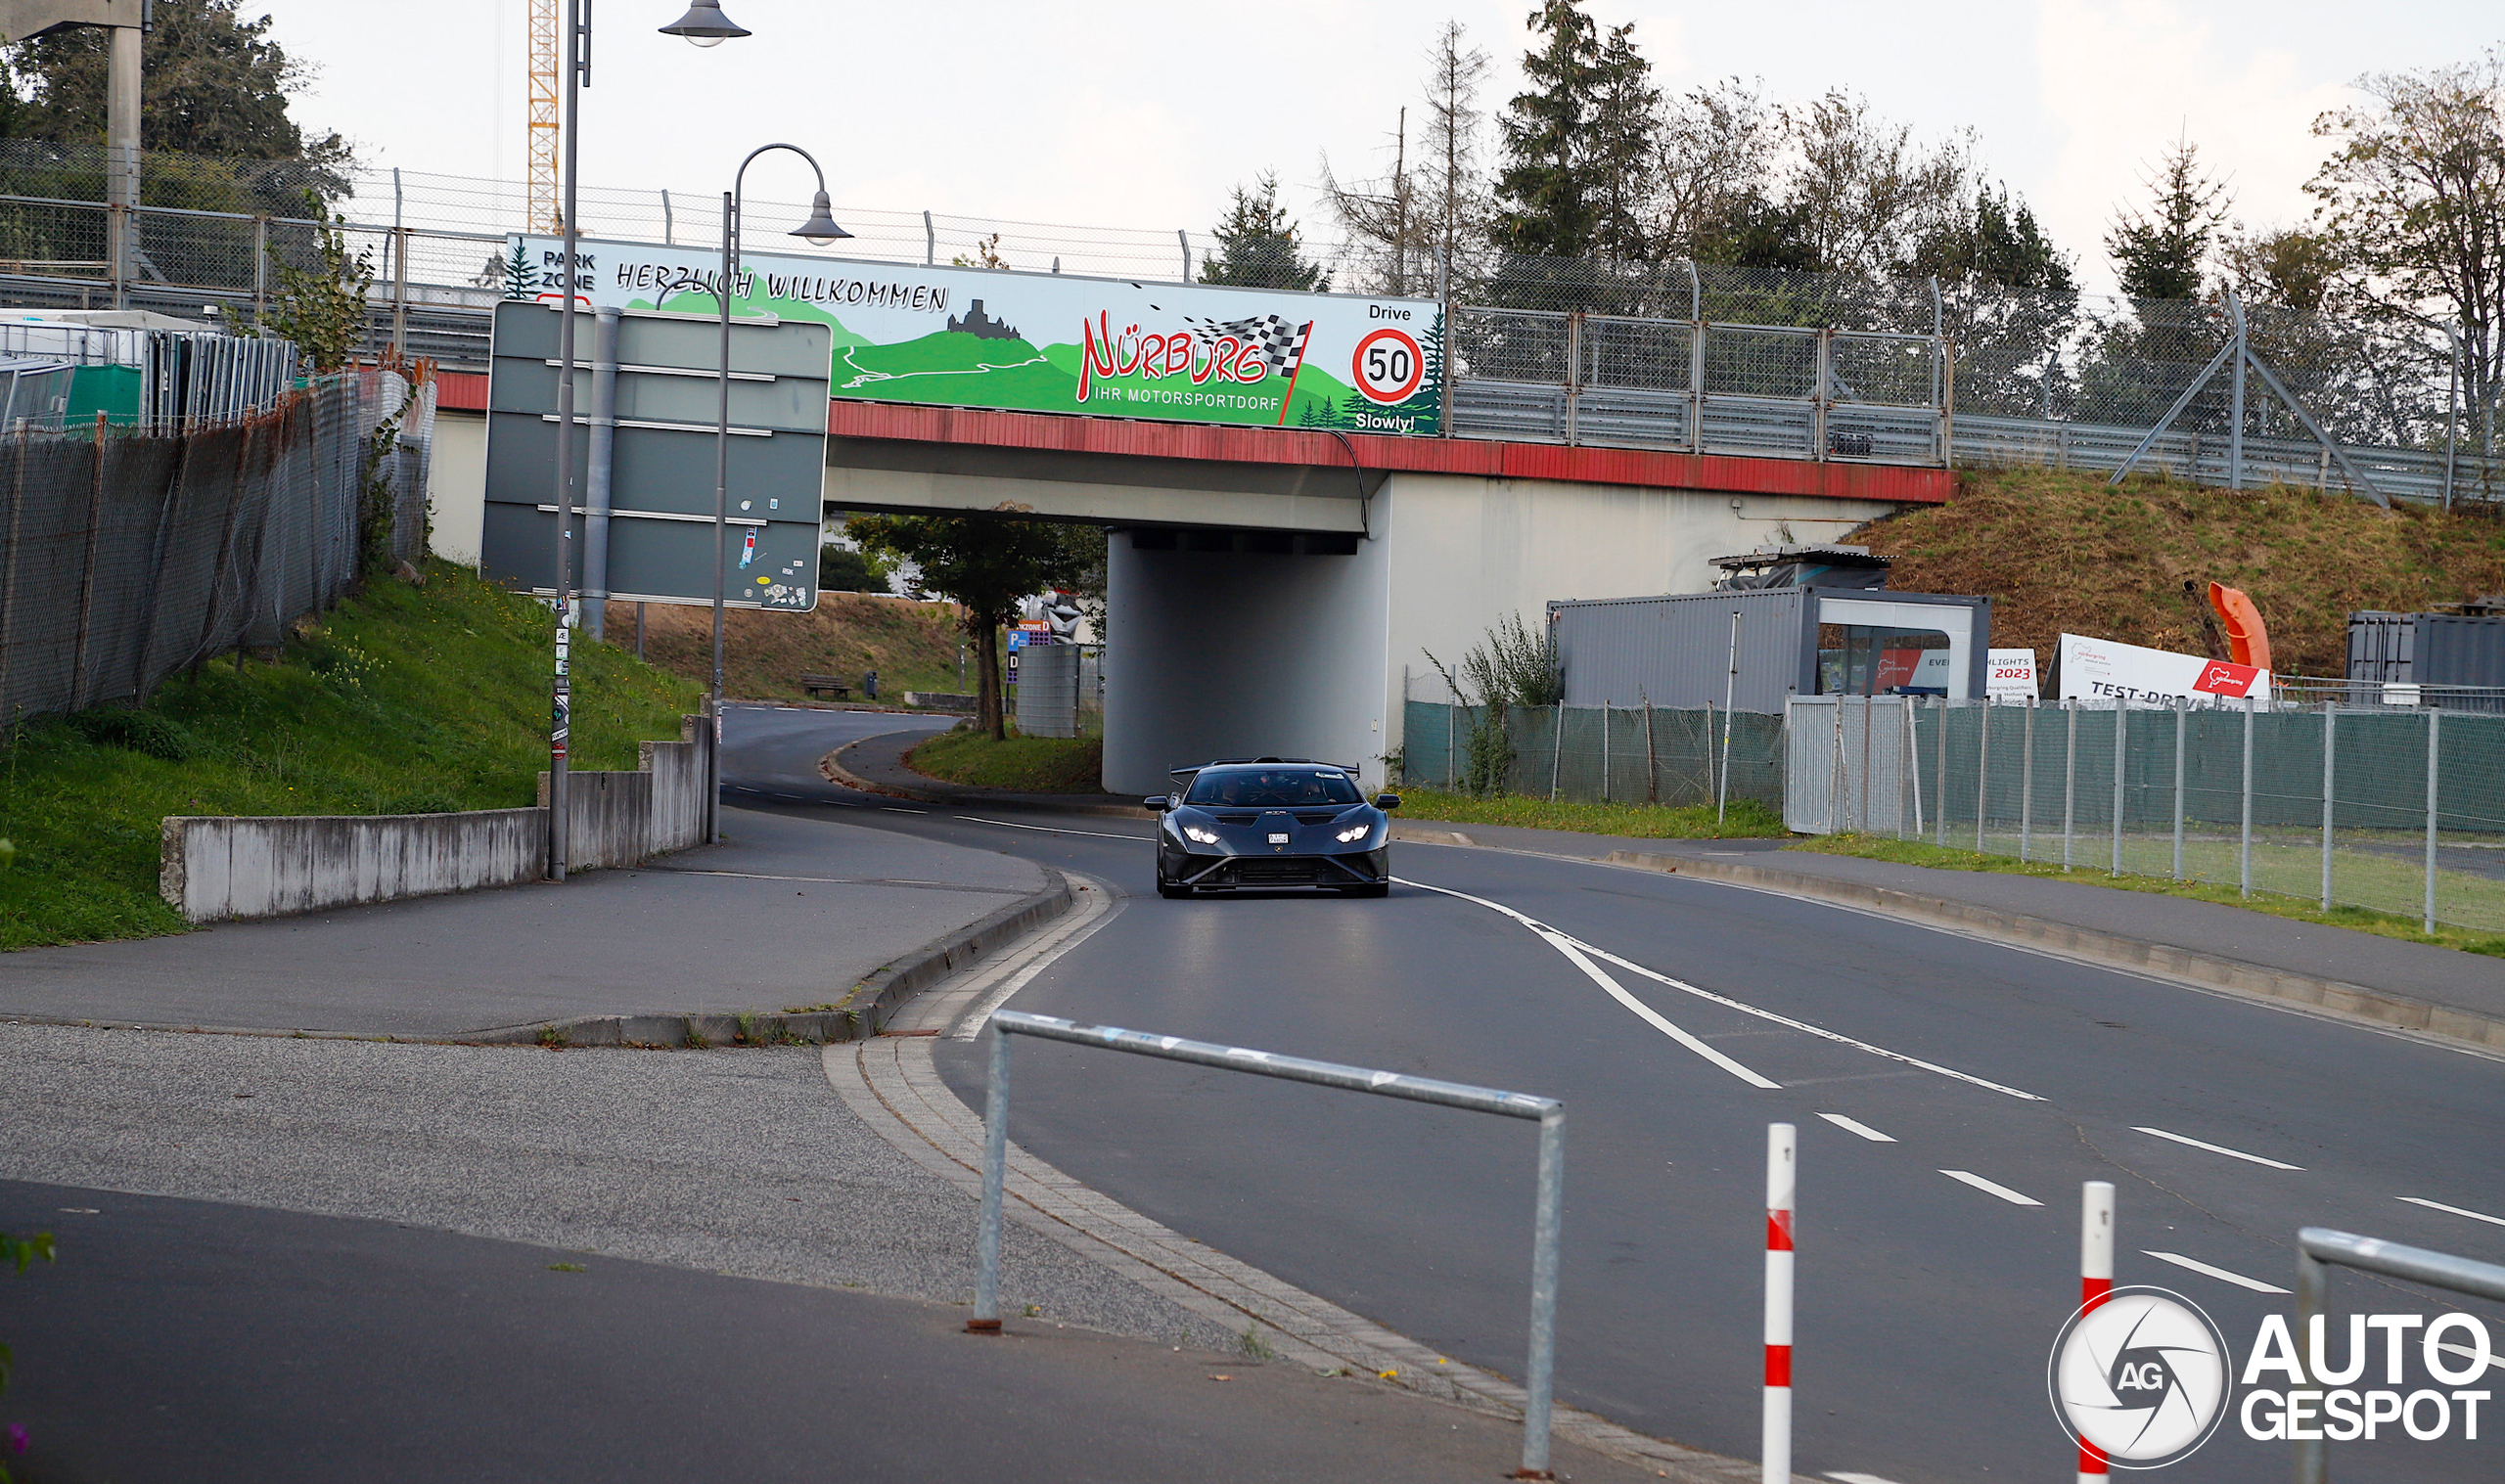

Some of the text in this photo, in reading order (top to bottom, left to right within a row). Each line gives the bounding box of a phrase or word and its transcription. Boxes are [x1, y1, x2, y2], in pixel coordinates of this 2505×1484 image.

[543, 250, 596, 271] PARK
[617, 262, 949, 310] HERZLICH WILLKOMMEN
[1369, 304, 1411, 321] Drive
[1368, 347, 1409, 383] 50
[1095, 386, 1280, 411] IHR MOTORSPORTDORF
[1355, 413, 1415, 433] Slowly!
[1042, 621, 1050, 631] D
[1010, 633, 1019, 646] P
[1010, 655, 1018, 668] D
[1995, 668, 2030, 680] 2023
